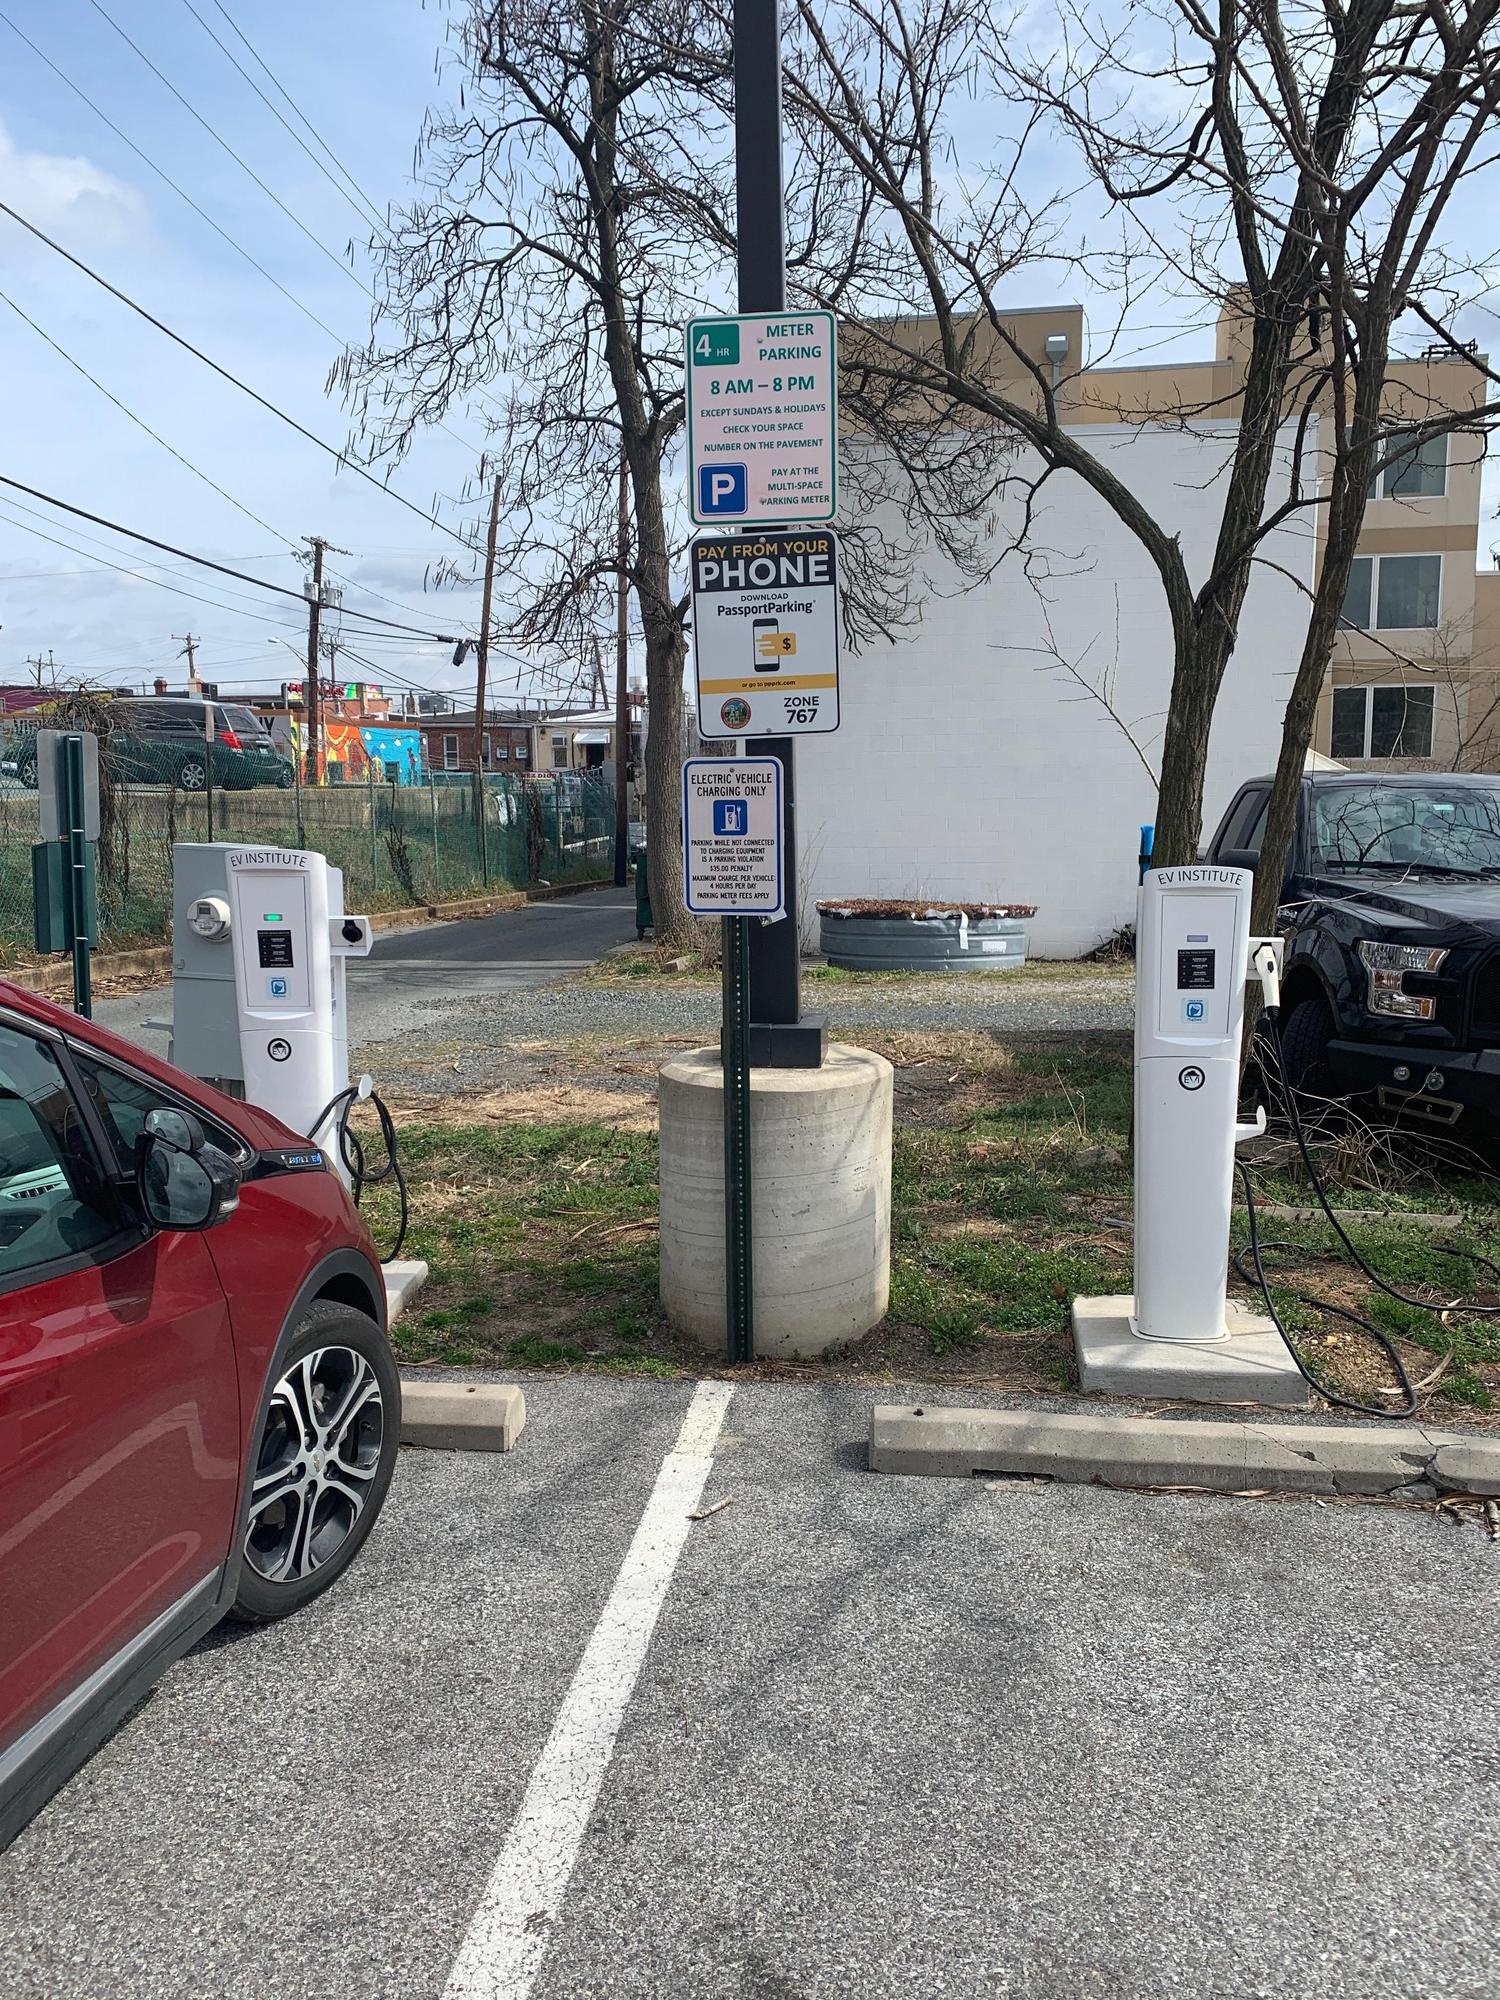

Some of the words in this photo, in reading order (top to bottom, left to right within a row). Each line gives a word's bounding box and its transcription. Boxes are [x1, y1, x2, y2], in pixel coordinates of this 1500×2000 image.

[766, 323, 814, 338] METER
[695, 334, 712, 358] 4
[716, 347, 730, 357] HR
[759, 345, 822, 361] PARKING
[710, 380, 720, 395] 8
[724, 379, 754, 394] AM
[772, 377, 783, 392] 8
[787, 375, 815, 391] PM
[700, 407, 731, 418] EXCEPT
[733, 406, 773, 416] SUNDAYS
[774, 405, 782, 414] &
[783, 403, 826, 414] HOLIDAYS
[722, 425, 750, 434] CHECK
[751, 423, 776, 433] YOUR
[777, 422, 804, 432] SPACE
[704, 442, 741, 453] NUMBER
[743, 441, 756, 451] ON
[758, 441, 775, 450] THE
[776, 439, 824, 449] PAVEMENT
[771, 468, 788, 477] PAY
[789, 468, 802, 476] AT
[803, 466, 819, 475] THE
[711, 473, 736, 506] P
[767, 481, 824, 491] MULTI-SPACE
[759, 496, 799, 506] ARKING
[800, 495, 830, 504] METER
[698, 546, 728, 560] PAY
[732, 543, 778, 559] FROM
[783, 539, 829, 554] YOUR
[698, 554, 830, 590] PHONE
[740, 593, 789, 602] DOWNLOAD
[783, 696, 820, 708] ZONE
[786, 709, 818, 724] 767
[691, 773, 732, 785] ELECTRIC
[735, 773, 772, 784] VEHICLE
[697, 786, 741, 797] CHARGING
[744, 786, 767, 797] ONLY
[230, 855, 243, 867] EV
[245, 852, 308, 868] INSTITUTE
[1157, 871, 1174, 885] EV
[1178, 870, 1244, 886] INSTITUTE
